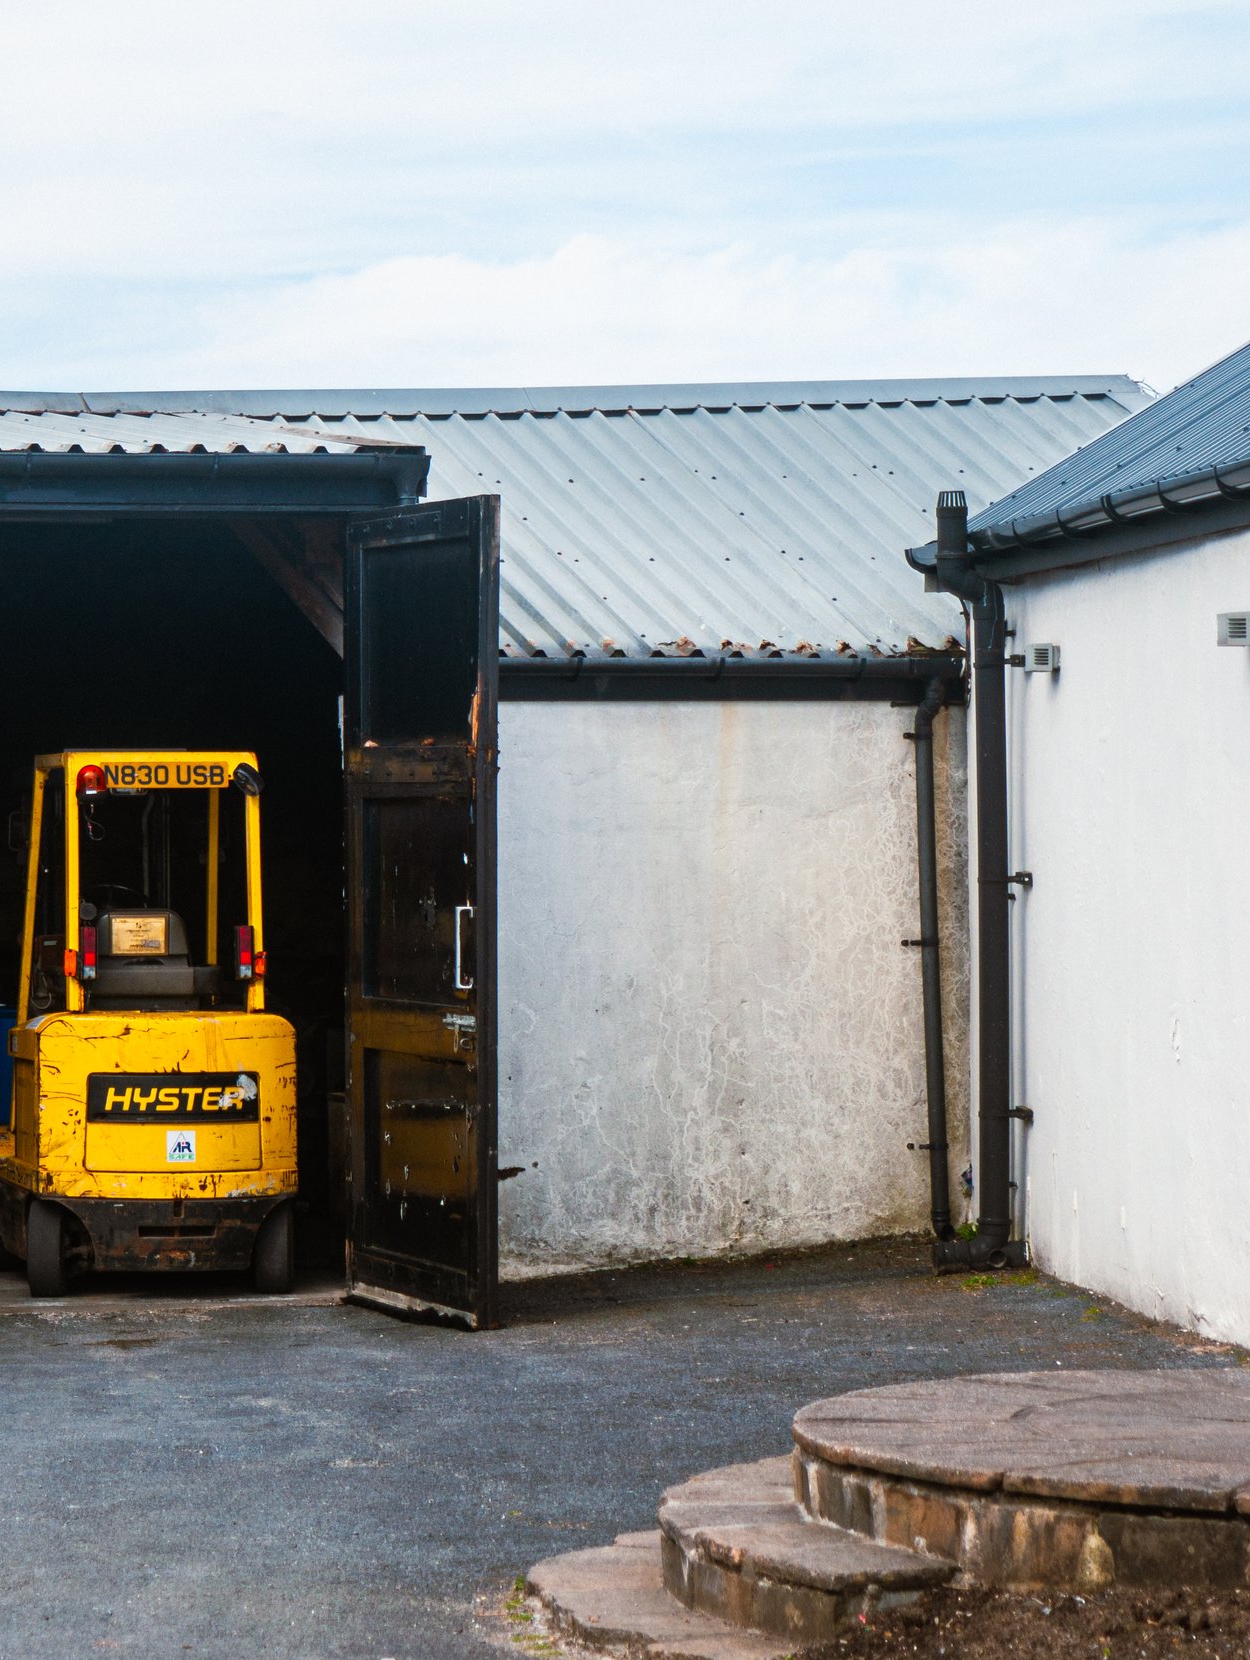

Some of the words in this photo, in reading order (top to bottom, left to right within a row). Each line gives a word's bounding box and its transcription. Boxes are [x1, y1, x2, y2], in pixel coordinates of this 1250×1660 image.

[104, 764, 169, 785] N830
[176, 764, 225, 785] USB
[104, 1087, 245, 1111] HYSTER
